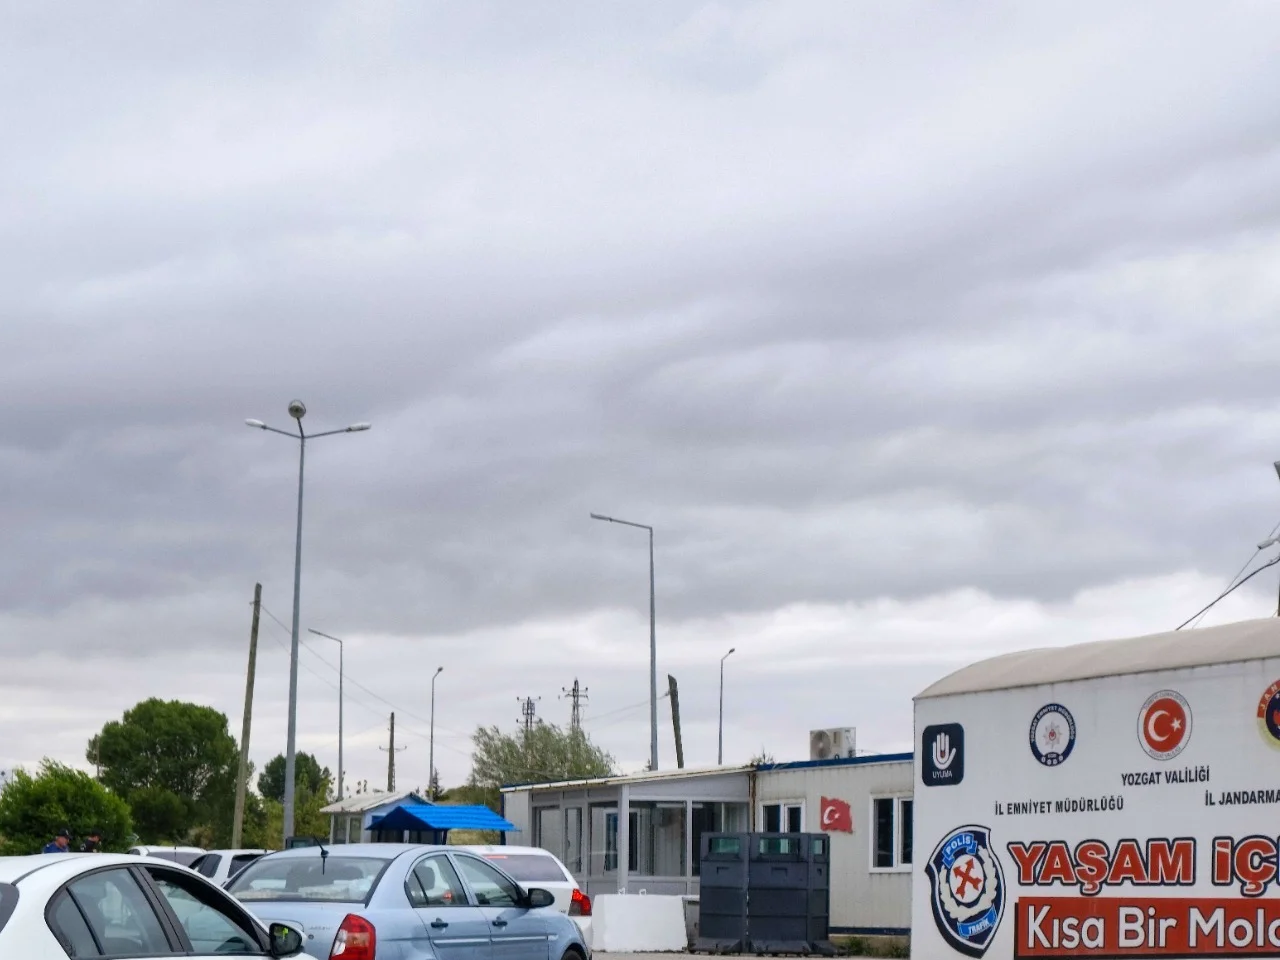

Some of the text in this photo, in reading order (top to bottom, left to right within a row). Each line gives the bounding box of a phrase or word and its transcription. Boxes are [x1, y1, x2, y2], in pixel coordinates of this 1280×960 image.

[1121, 765, 1210, 787] YOZGAT VALİLİĞİ
[995, 796, 1124, 815] İL EMNİYET MÜDÜRLÜĞÜ
[1205, 790, 1215, 806] İL
[946, 835, 971, 855] POLİS
[1007, 836, 1280, 897] YAŞAM İÇ
[1027, 904, 1105, 949] Kısa
[1118, 905, 1178, 949] Bir
